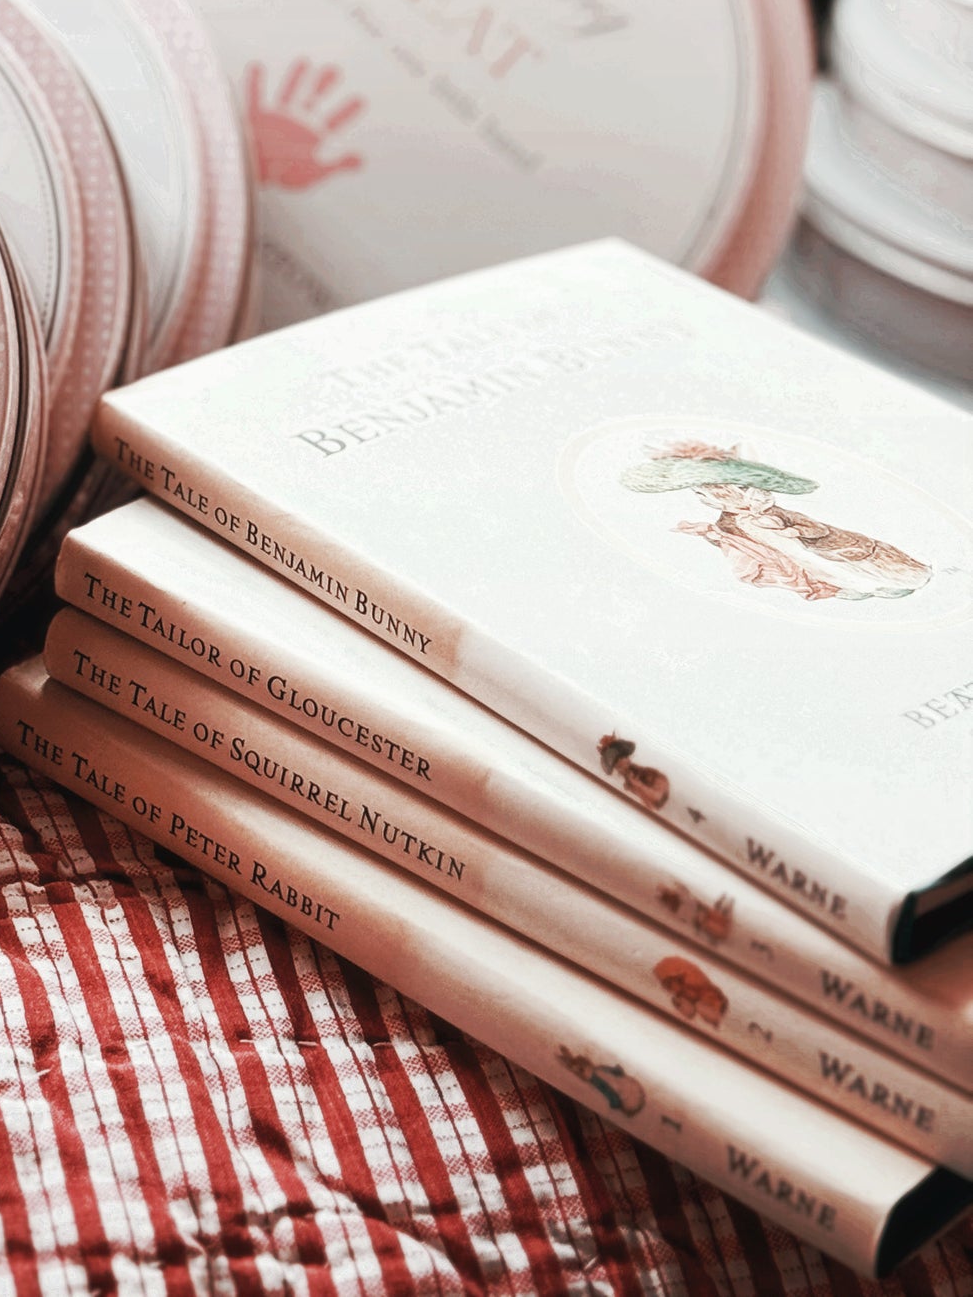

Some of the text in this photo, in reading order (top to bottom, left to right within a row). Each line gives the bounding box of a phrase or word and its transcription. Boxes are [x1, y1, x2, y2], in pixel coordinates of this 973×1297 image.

[291, 357, 544, 458] BENJAMIN
[114, 437, 432, 654] THE TALE OF BENJAMIN BUNNY
[84, 572, 432, 781] THE TAILOR OF GLOUCESTER
[901, 681, 973, 729] BEA
[73, 650, 466, 881] THE TALE OF SQUIRREL NUTKIN
[17, 720, 340, 931] THE TALE OF PETER RABBIT
[746, 837, 848, 920] WARNE
[819, 969, 936, 1050] WARNE
[817, 1051, 936, 1133] WARNE
[727, 1145, 837, 1232] WARNE
